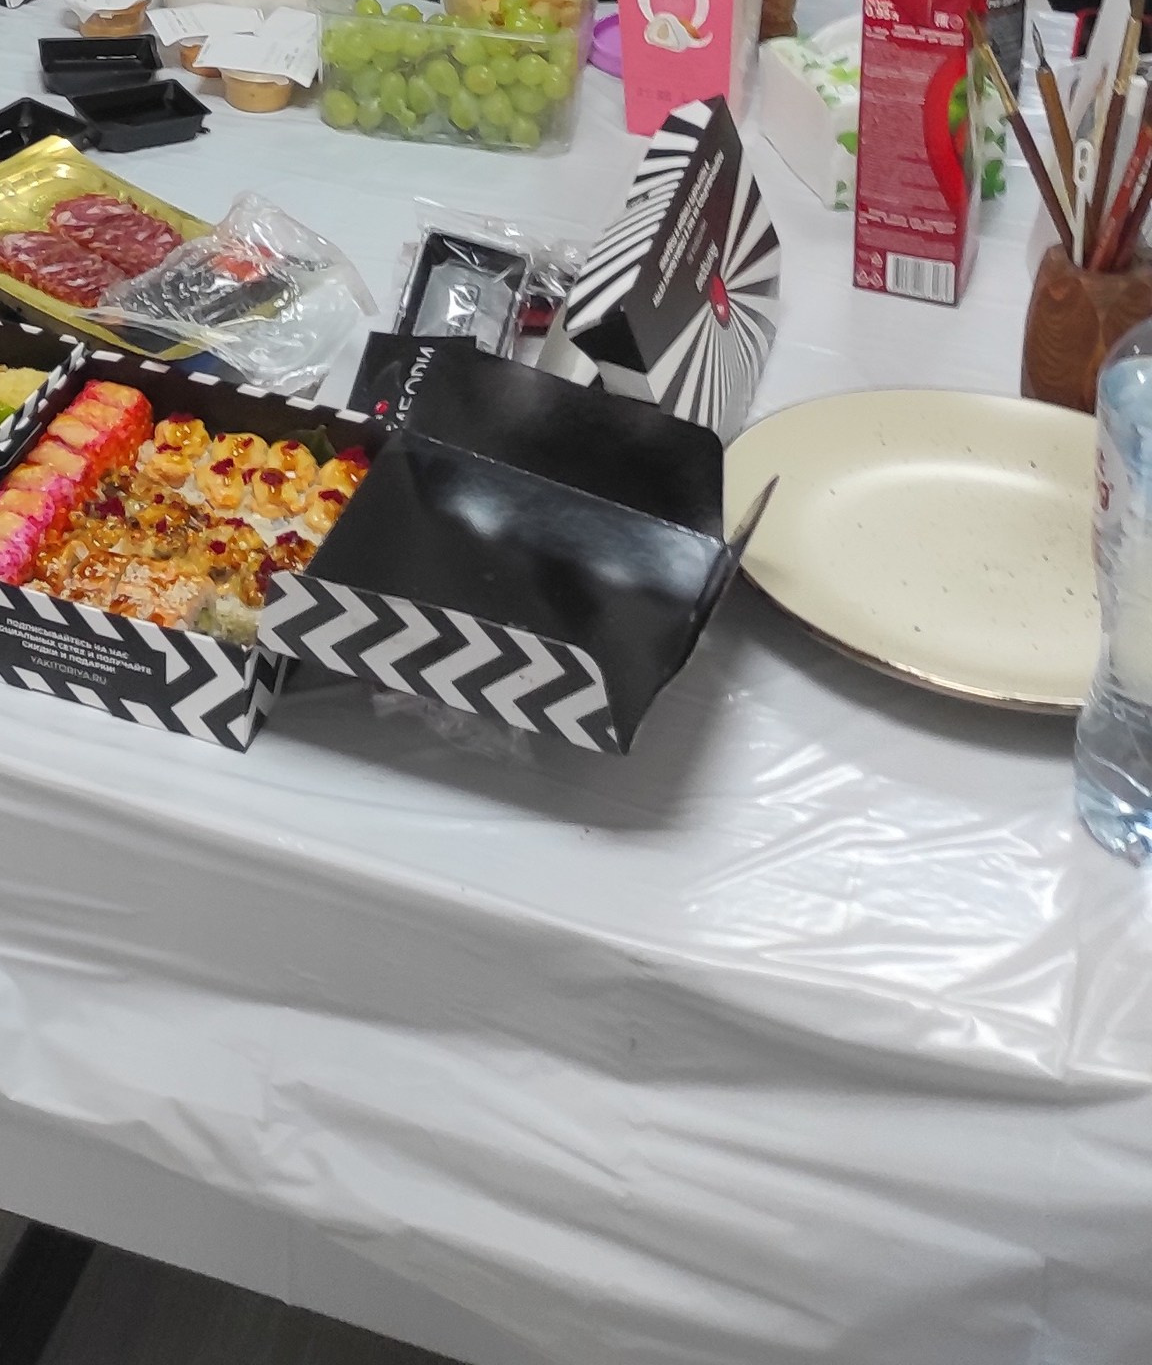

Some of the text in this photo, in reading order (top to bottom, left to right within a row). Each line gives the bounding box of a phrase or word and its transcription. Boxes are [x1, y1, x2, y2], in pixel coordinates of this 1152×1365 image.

[6, 618, 129, 659] ПОДПИСЫВАЙТЕСЬ НА НАС
[21, 640, 58, 657] СКИДКИ
[60, 651, 67, 660] И
[30, 655, 107, 685] YAKITORIYA.RU
[58, 642, 86, 657] СЕТЯХ
[87, 650, 95, 659] И
[96, 653, 152, 675] ПОЛУЧАЙТЕ
